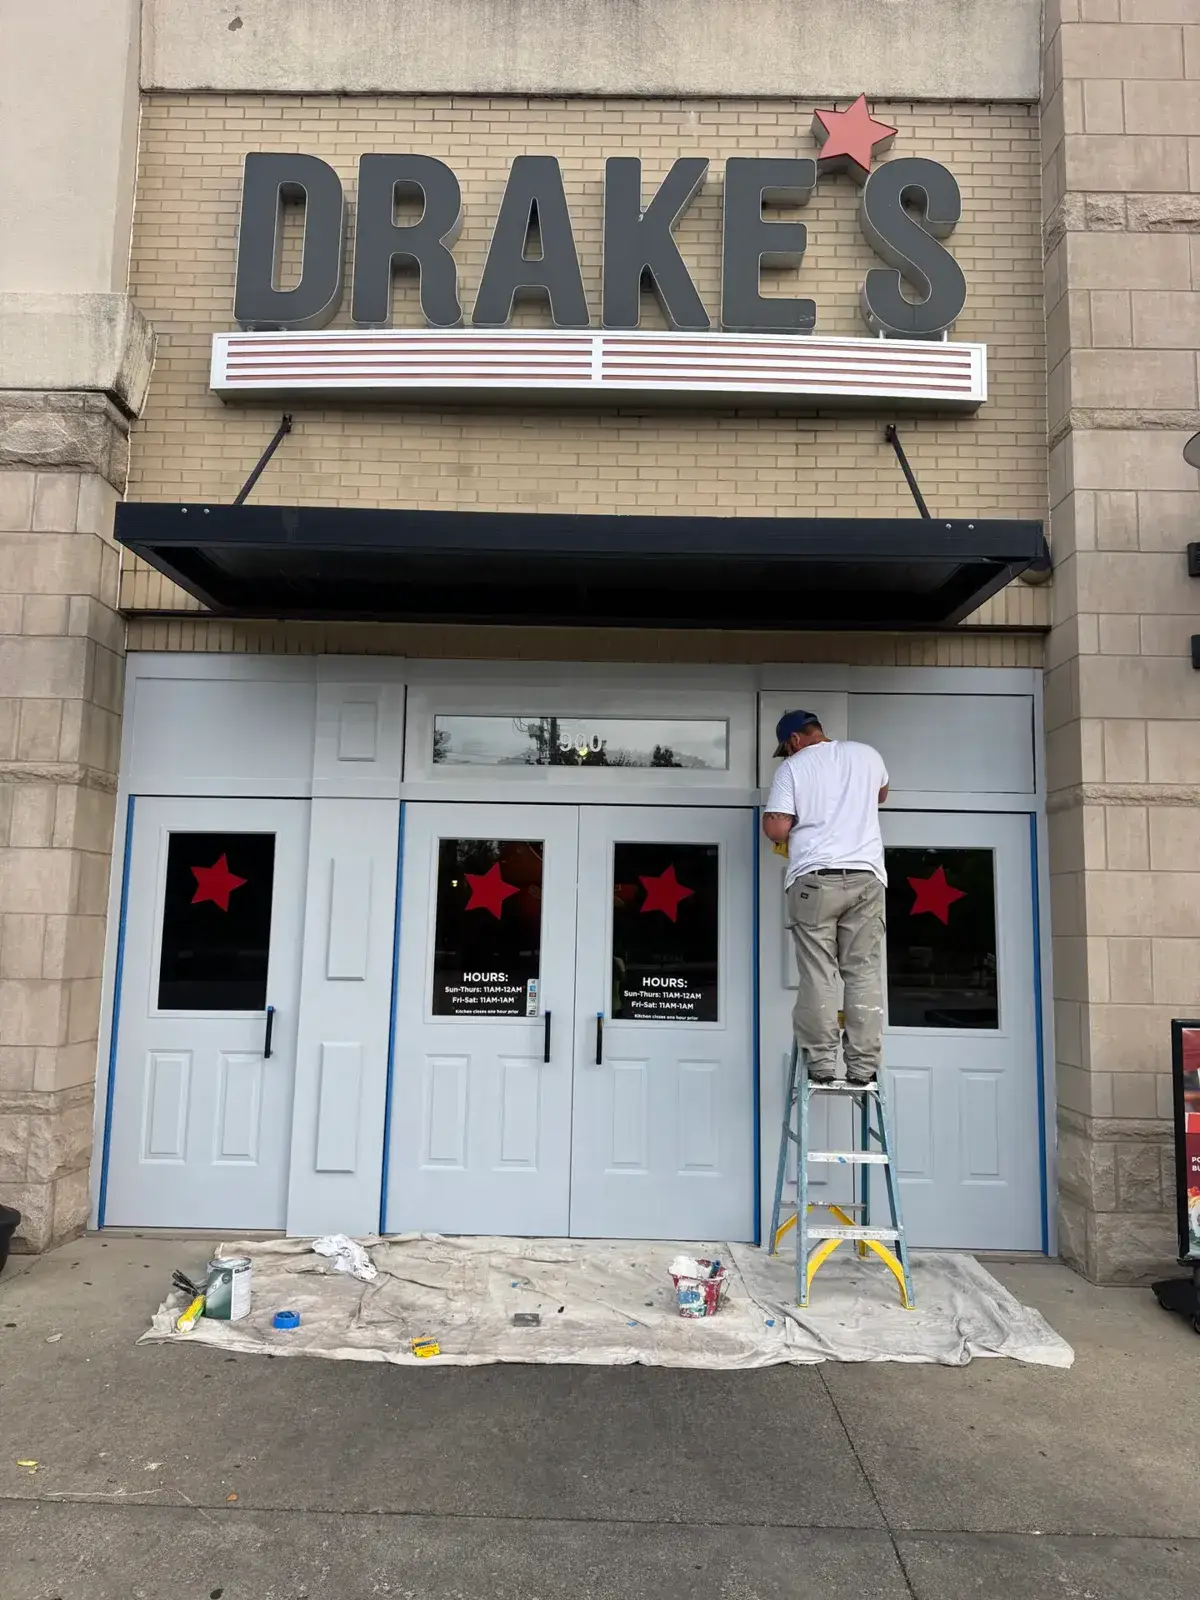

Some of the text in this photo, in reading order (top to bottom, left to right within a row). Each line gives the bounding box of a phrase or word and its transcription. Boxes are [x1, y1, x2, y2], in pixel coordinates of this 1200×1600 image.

[560, 733, 602, 752] 900
[463, 972, 509, 982] HOURS:
[642, 977, 688, 988] HOURS:
[624, 990, 702, 1000] Sun-Thurs: 11AM-12AM
